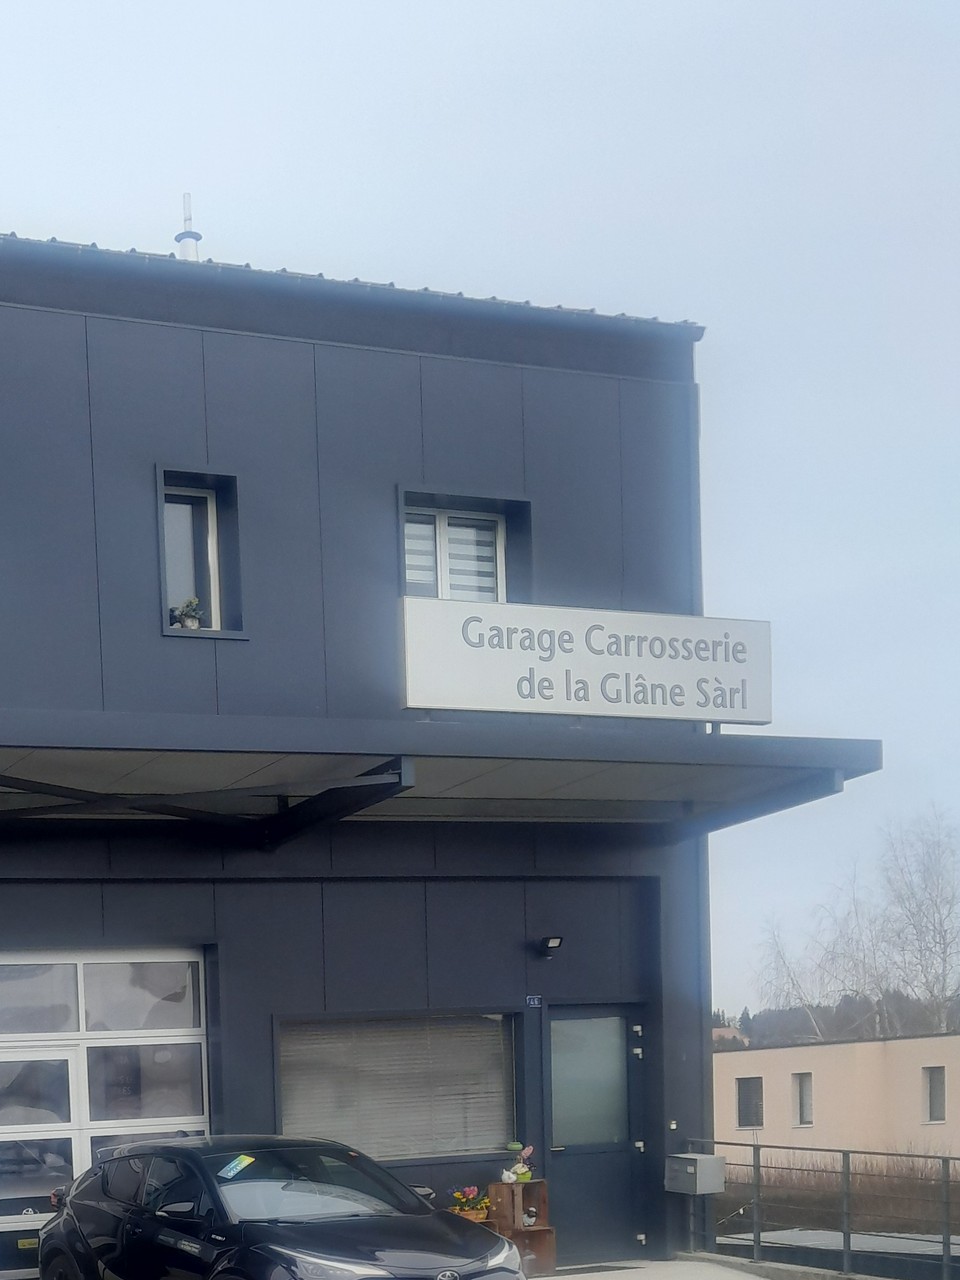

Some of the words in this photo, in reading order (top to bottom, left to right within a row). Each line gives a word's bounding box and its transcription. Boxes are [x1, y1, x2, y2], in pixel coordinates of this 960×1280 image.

[461, 616, 575, 662] Garage
[584, 624, 748, 664] Carrosserie
[517, 667, 554, 700] de
[565, 669, 590, 702] la
[600, 673, 686, 707] Glâne
[696, 677, 748, 710] Sàrl
